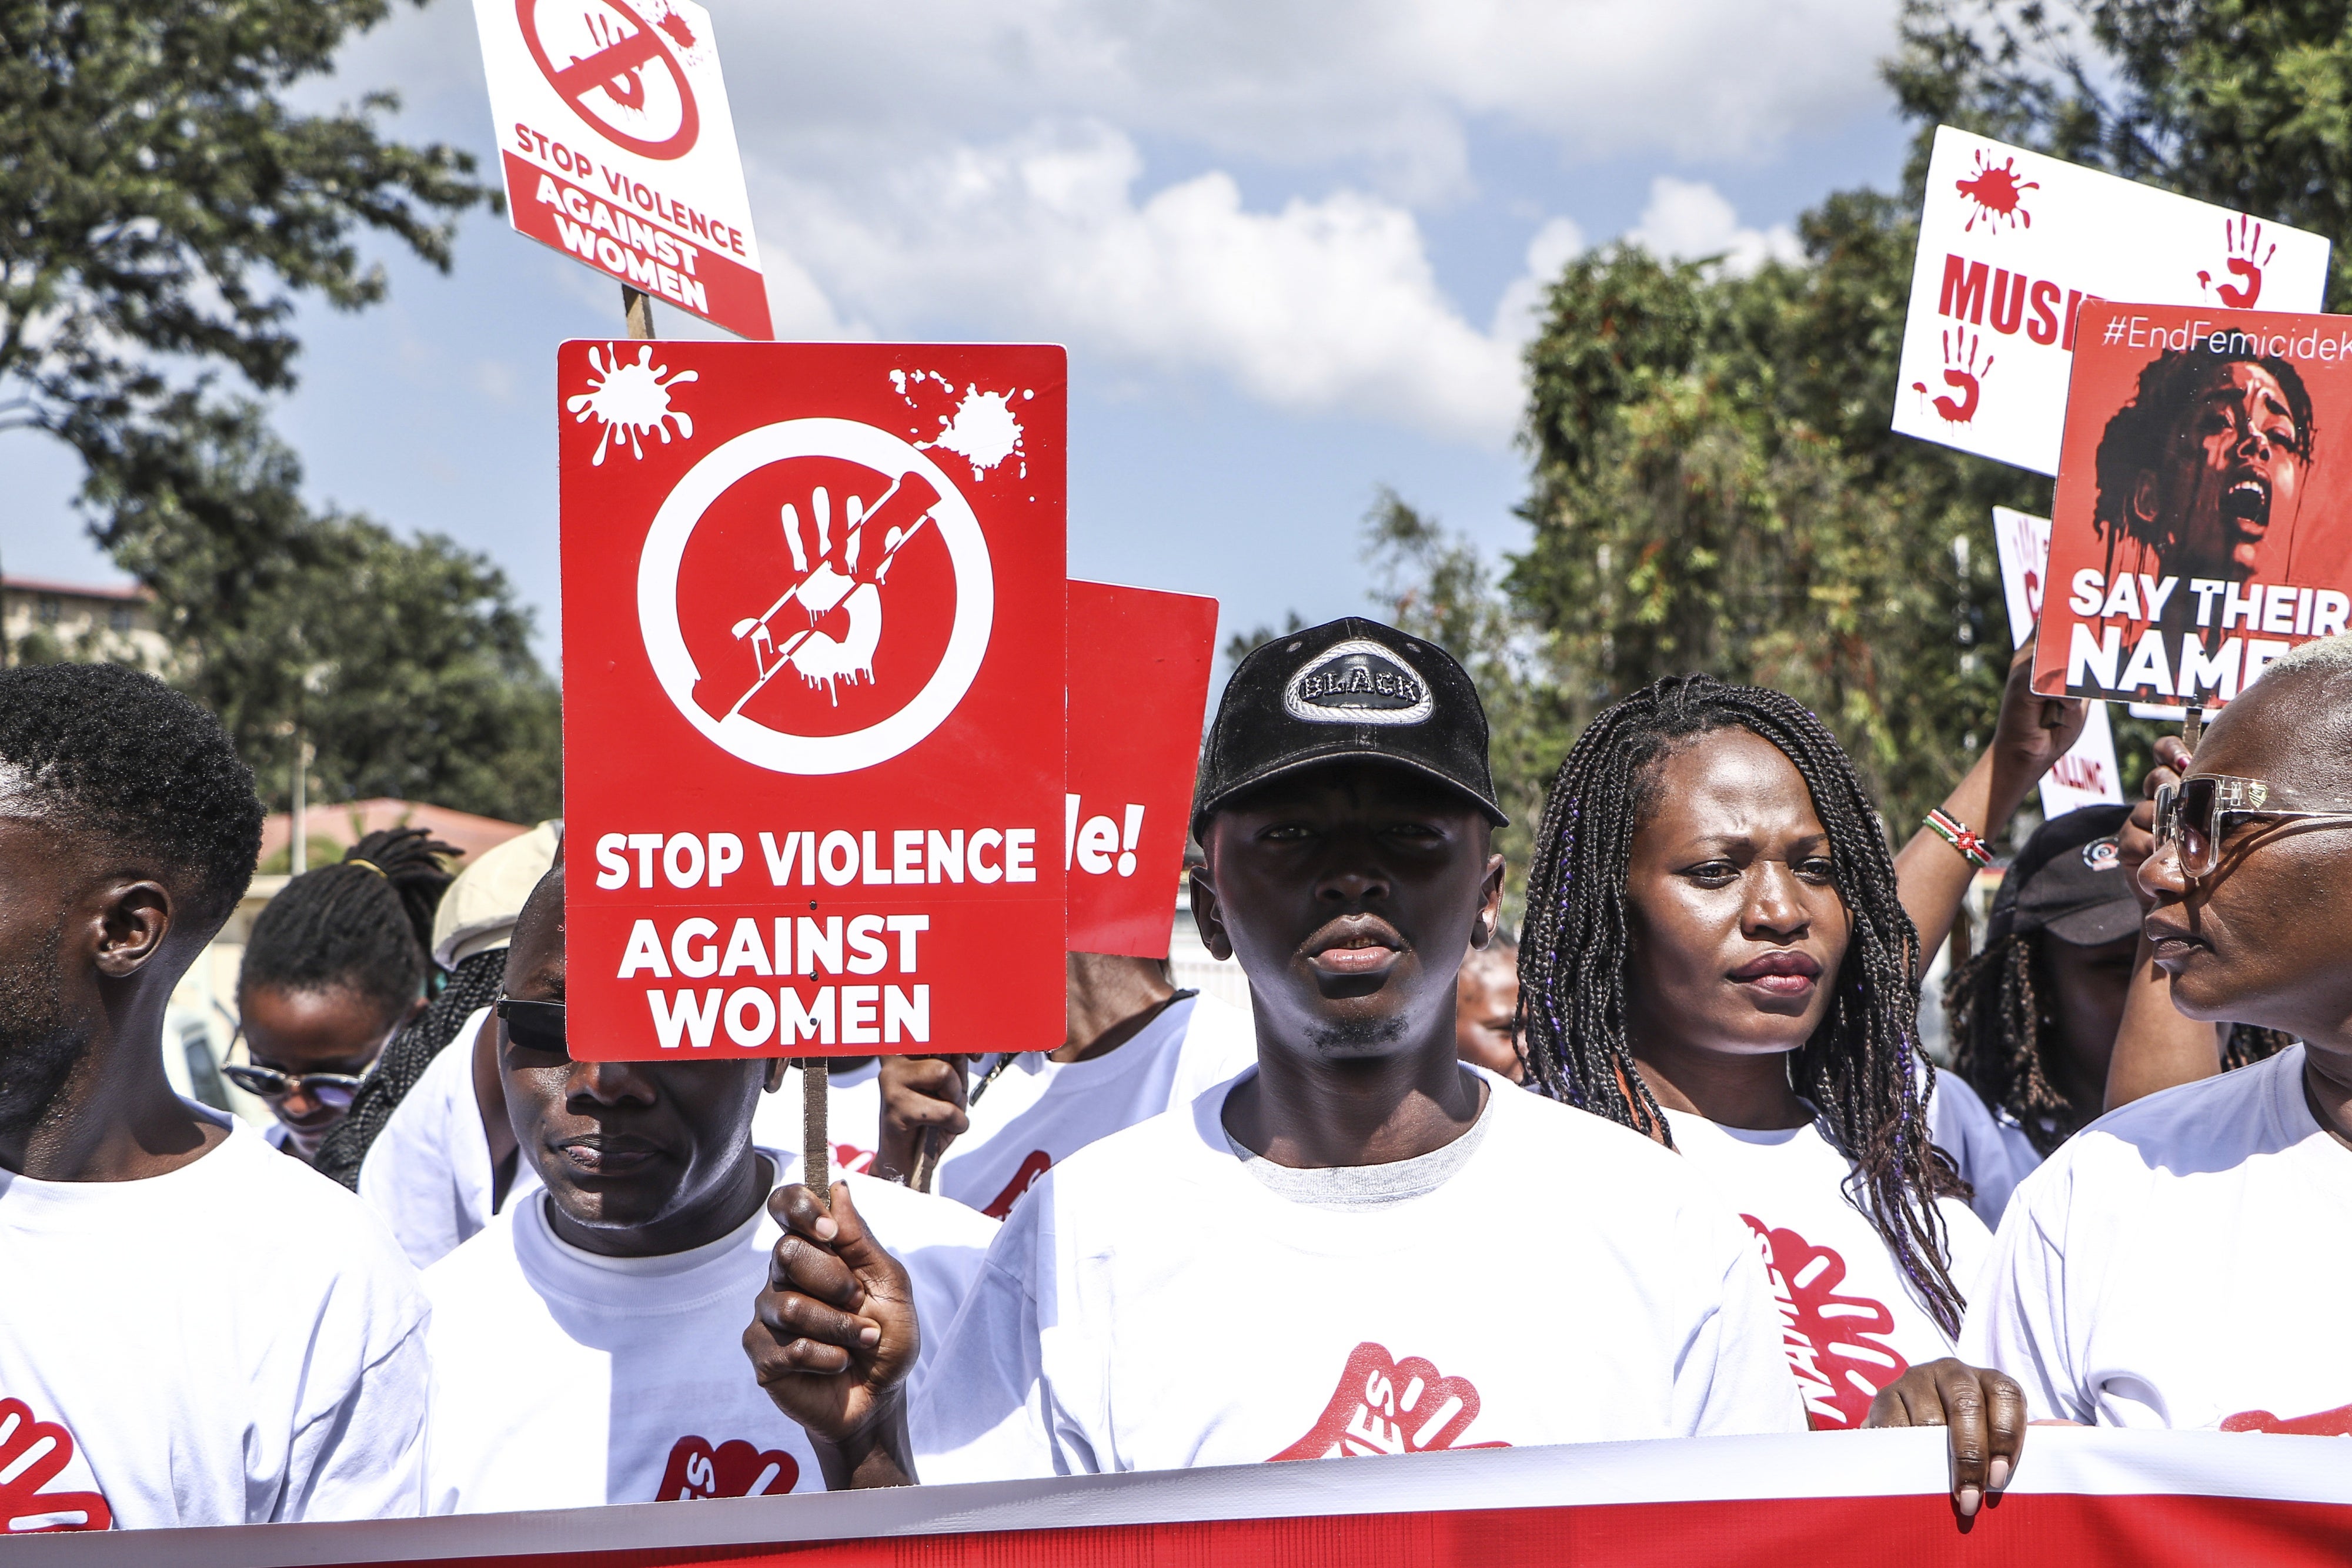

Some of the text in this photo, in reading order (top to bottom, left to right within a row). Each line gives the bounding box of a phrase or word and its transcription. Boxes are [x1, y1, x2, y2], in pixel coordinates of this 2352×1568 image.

[514, 123, 746, 258] STOP VIOLENCE
[536, 174, 699, 276] AGAINST
[553, 213, 709, 315] WOMEN
[1939, 253, 2117, 352] MUSI
[2069, 568, 2351, 637] SAY THEIR
[1301, 666, 1421, 703] BLACK
[595, 827, 1037, 890] STOP VIOLENCE
[616, 914, 930, 979] AGAINST
[646, 984, 931, 1048] WOMEN
